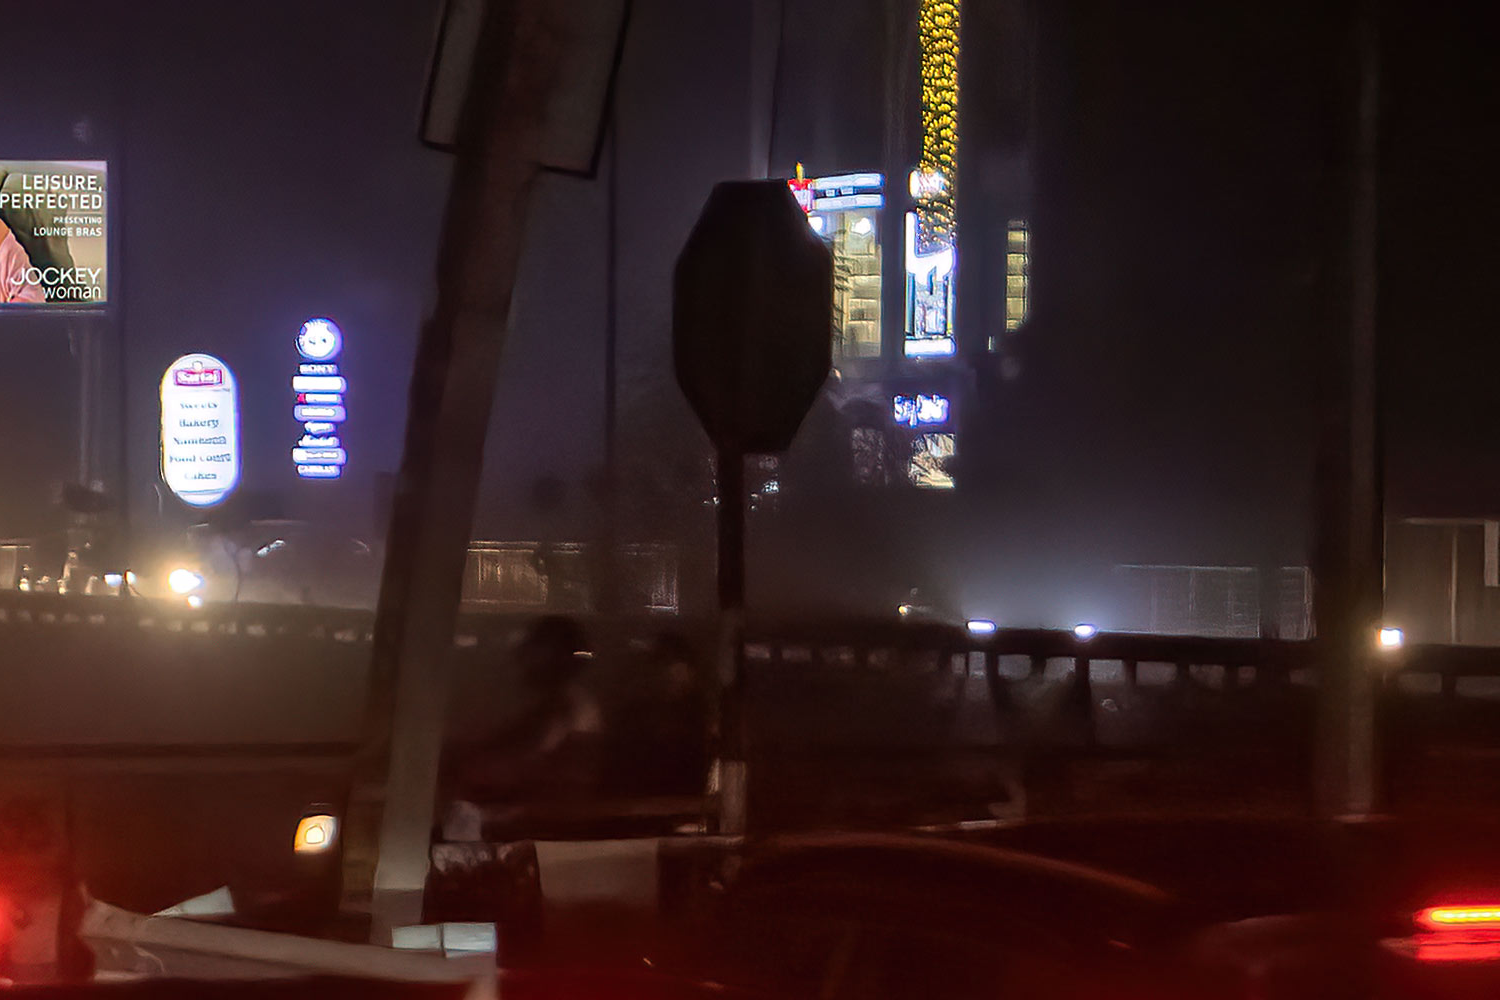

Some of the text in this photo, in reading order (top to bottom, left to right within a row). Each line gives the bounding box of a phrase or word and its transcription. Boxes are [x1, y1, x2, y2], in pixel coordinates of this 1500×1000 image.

[22, 174, 102, 193] LEISURE,
[0, 193, 102, 209] PERFECTED
[53, 216, 102, 225] PRESENTING
[33, 227, 102, 237] LOUNGE BRAS
[10, 266, 102, 286] JOCKEY
[42, 285, 101, 300] woman
